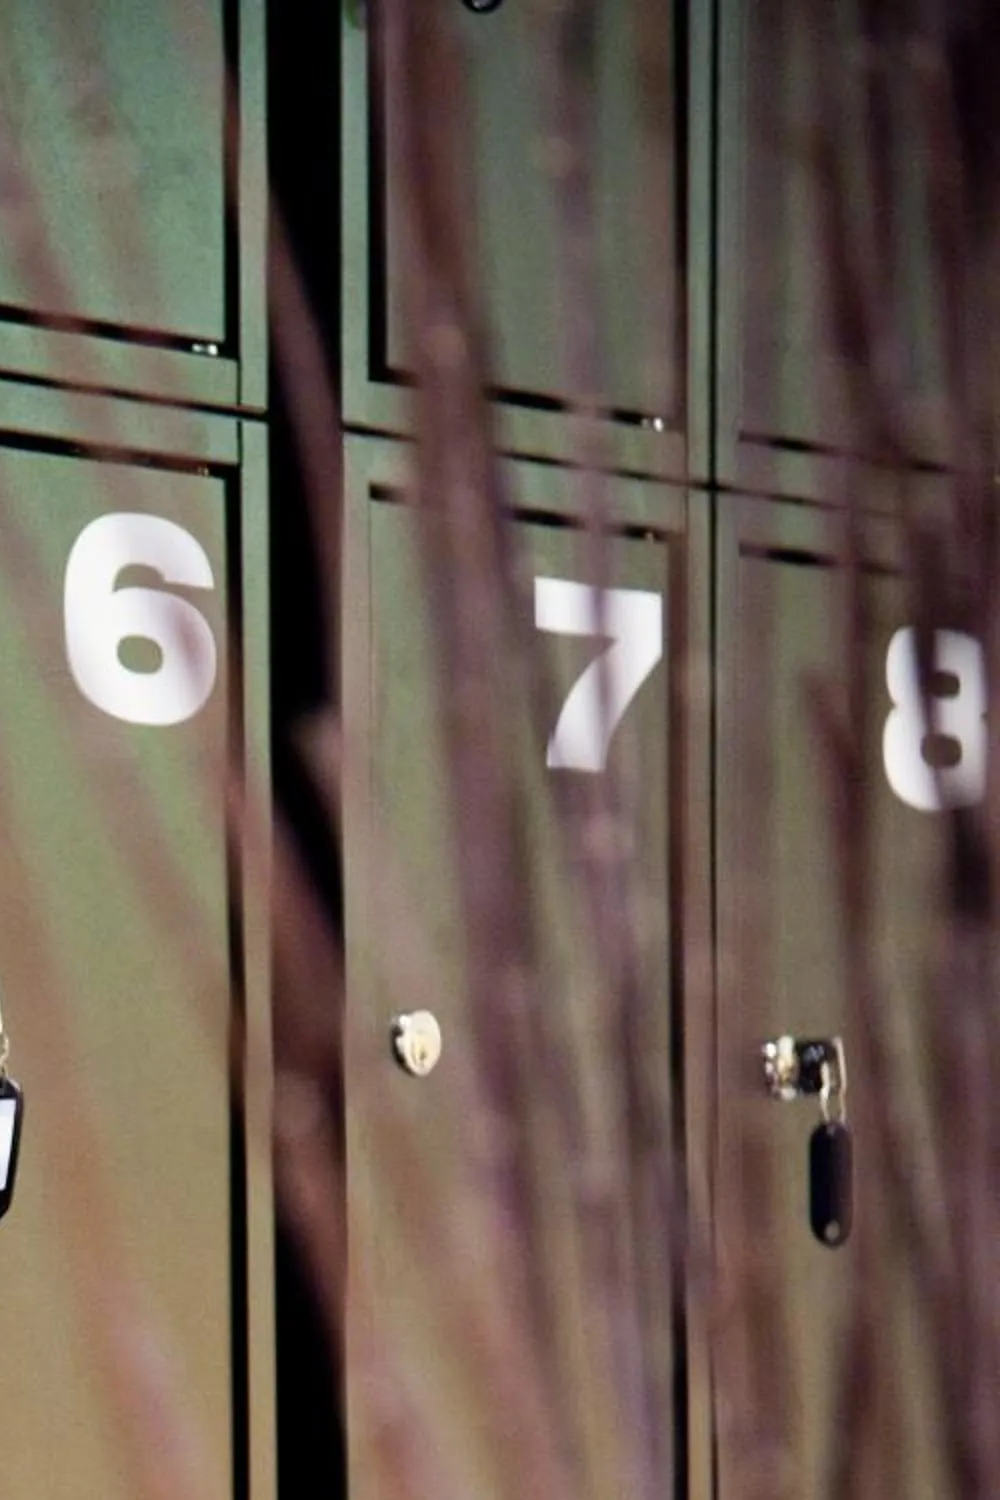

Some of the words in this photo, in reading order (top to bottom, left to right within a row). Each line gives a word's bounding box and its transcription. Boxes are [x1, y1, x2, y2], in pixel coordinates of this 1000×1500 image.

[61, 512, 217, 727] 6
[533, 575, 663, 773] 7
[883, 625, 988, 811] 8
